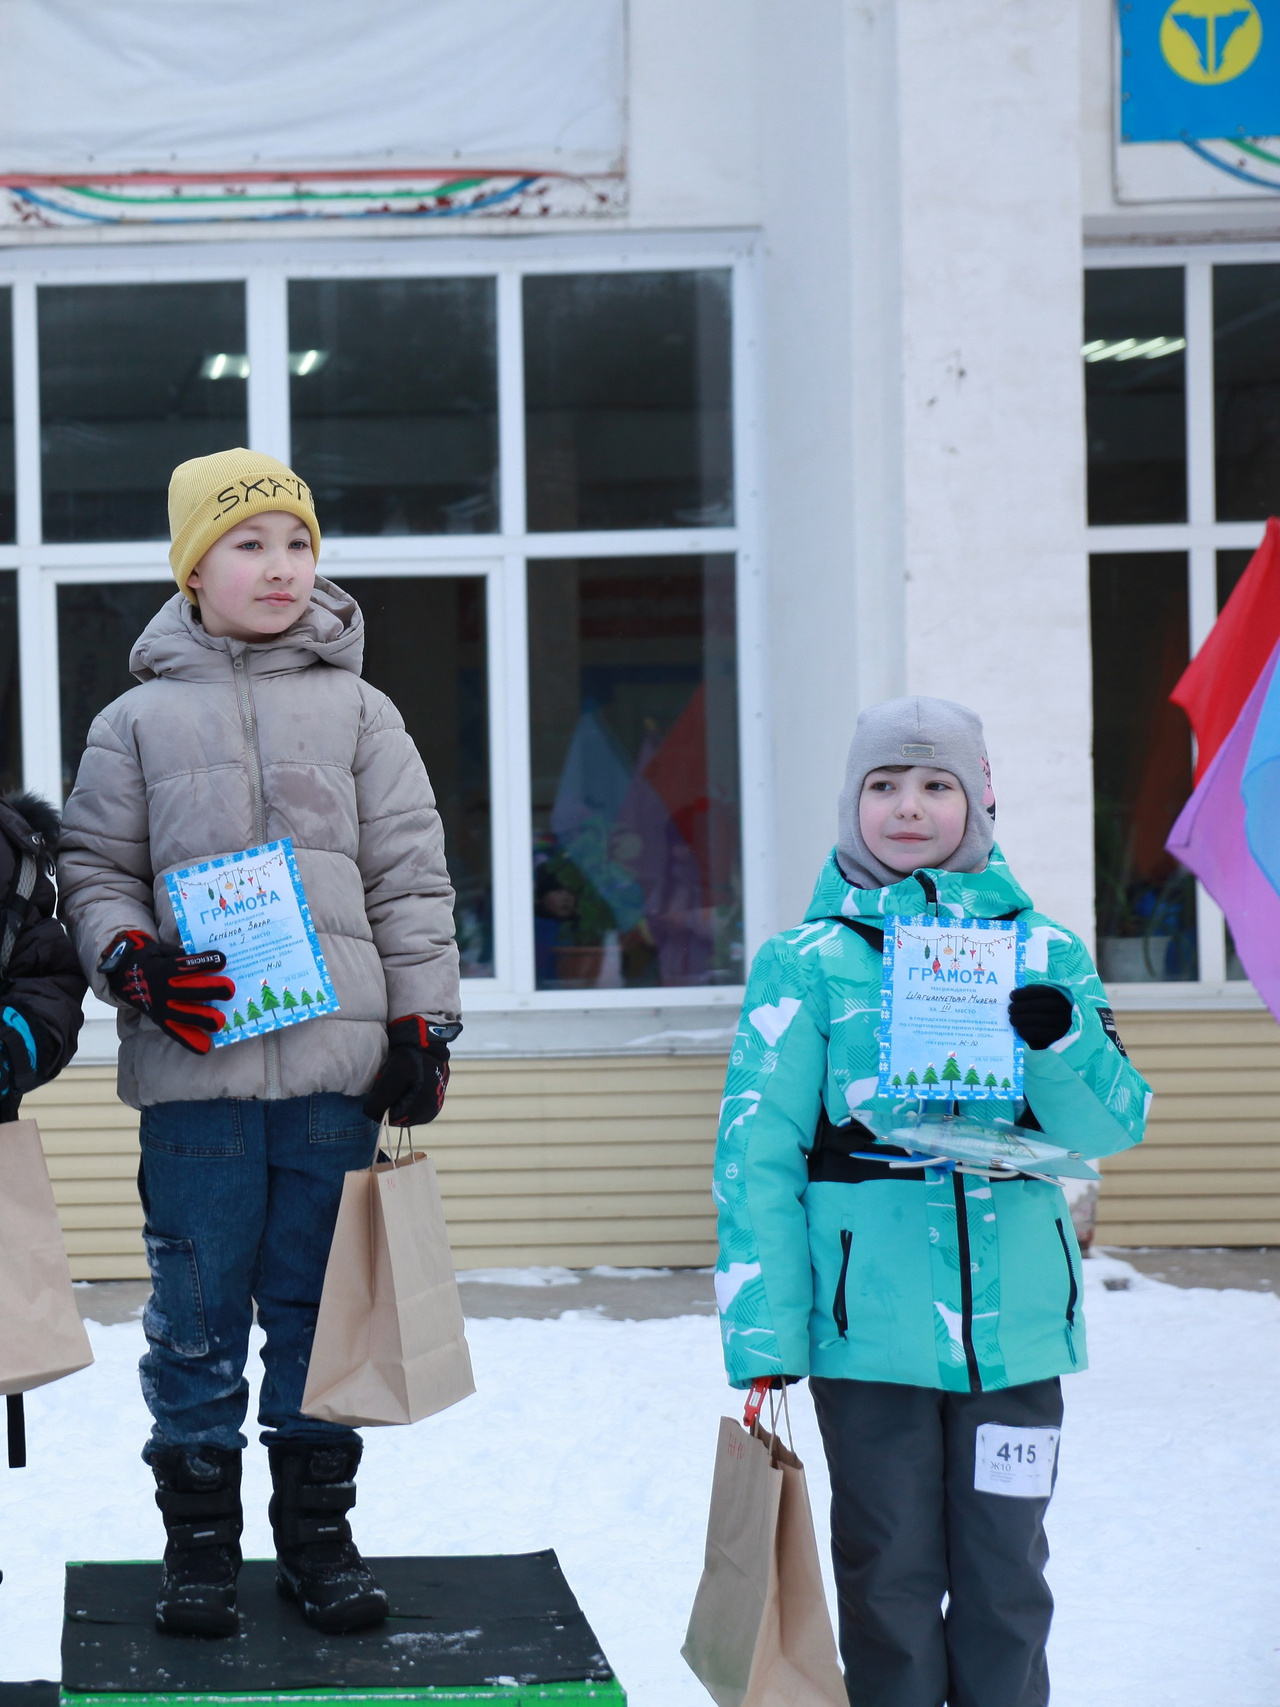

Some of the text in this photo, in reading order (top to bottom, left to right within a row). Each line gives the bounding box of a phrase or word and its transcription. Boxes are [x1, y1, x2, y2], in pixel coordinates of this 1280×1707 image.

[200, 890, 281, 924] ГРАМОТА
[251, 931, 271, 940] МЕСТО
[908, 967, 998, 985] ГРАМОТА
[996, 1442, 1036, 1464] 415
[990, 1461, 1012, 1472] Ж10
